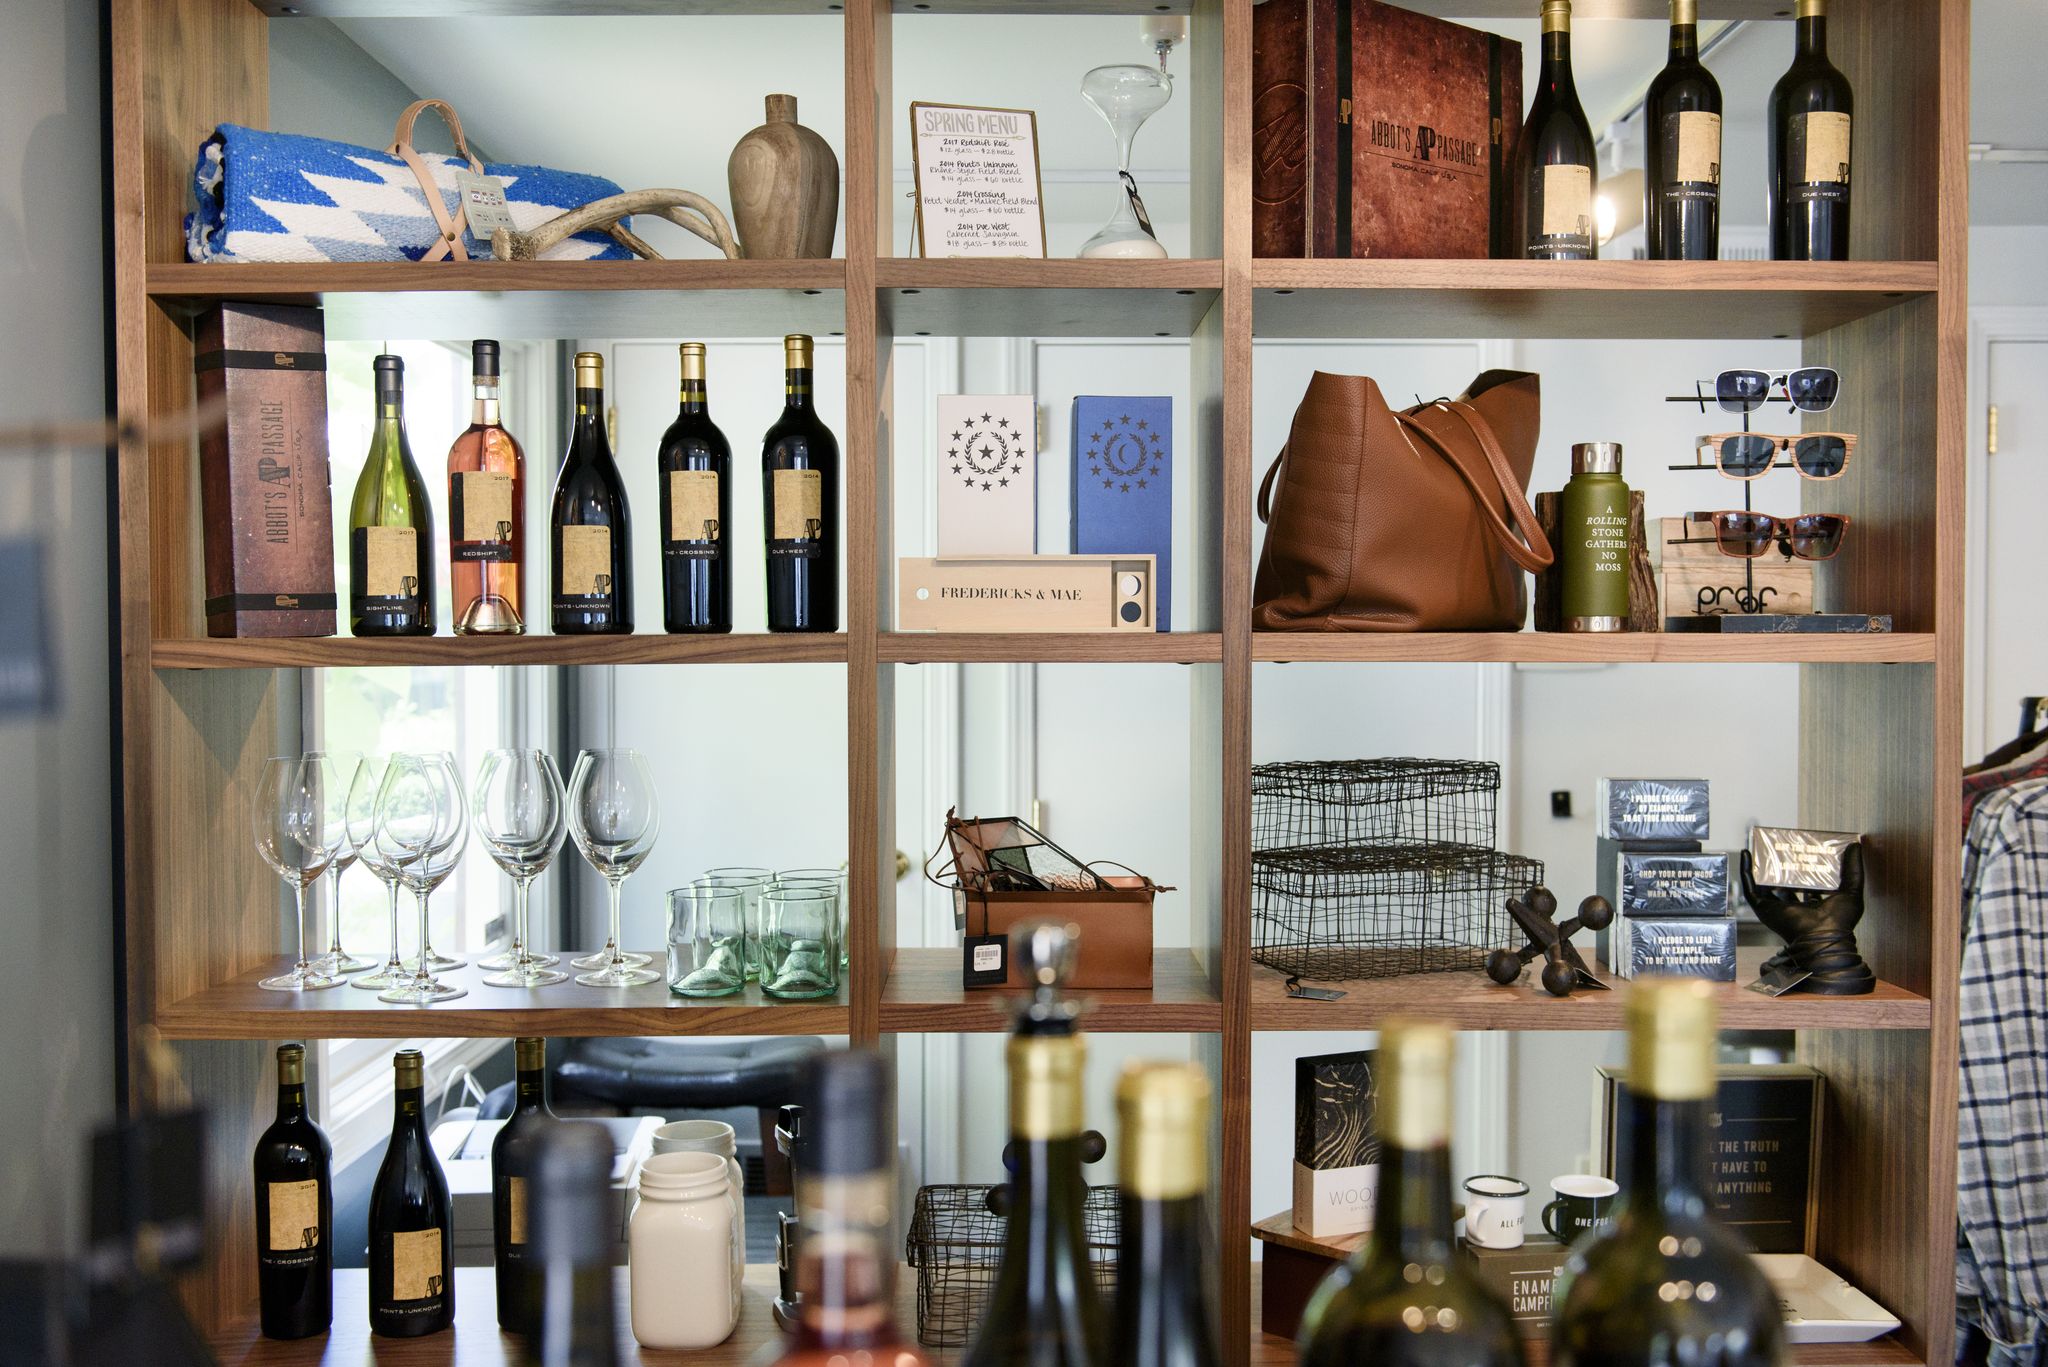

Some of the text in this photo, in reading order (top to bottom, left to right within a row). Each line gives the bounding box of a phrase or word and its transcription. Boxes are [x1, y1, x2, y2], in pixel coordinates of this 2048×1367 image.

[924, 111, 1018, 135] SPRING MENU
[1371, 120, 1411, 153] ABBOT'S
[1437, 135, 1477, 166] PASSAGE
[974, 191, 1005, 200] Crossing
[991, 222, 1011, 231] West
[260, 400, 284, 462] PASSAGE
[1606, 505, 1613, 513] A
[266, 492, 289, 544] ABBOT'S
[1586, 517, 1627, 526] ROLLING
[1592, 528, 1623, 537] STONE
[1585, 540, 1627, 549] GATHERS
[1602, 551, 1617, 560] NO
[1595, 563, 1621, 571] MOSS
[941, 587, 1082, 601] FREDERICKS & MAE
[1638, 804, 1648, 813] BY
[1623, 814, 1696, 822] TO BE TRUE AND BRAVE
[1639, 870, 1713, 879] CHOP YOUR OWN WOOD
[1671, 880, 1677, 888] IT
[1647, 890, 1667, 898] WARM
[1653, 936, 1712, 944] I PLEDGE TO LEAD
[1661, 946, 1670, 954] BY
[1645, 957, 1654, 965] TO
[1655, 957, 1664, 965] BE
[1685, 956, 1699, 964] AND
[1701, 956, 1721, 964] BRAVE
[1719, 1141, 1739, 1153] THE
[1744, 1140, 1779, 1152] TRUTH
[1722, 1161, 1749, 1173] HAVE
[1753, 1161, 1767, 1172] TO
[1717, 1182, 1772, 1194] ANYTHING
[1500, 1216, 1525, 1228] ALL FO
[1575, 1217, 1592, 1227] ONE
[1513, 1279, 1559, 1295] ENAME
[1513, 1296, 1553, 1312] CAMPFI
